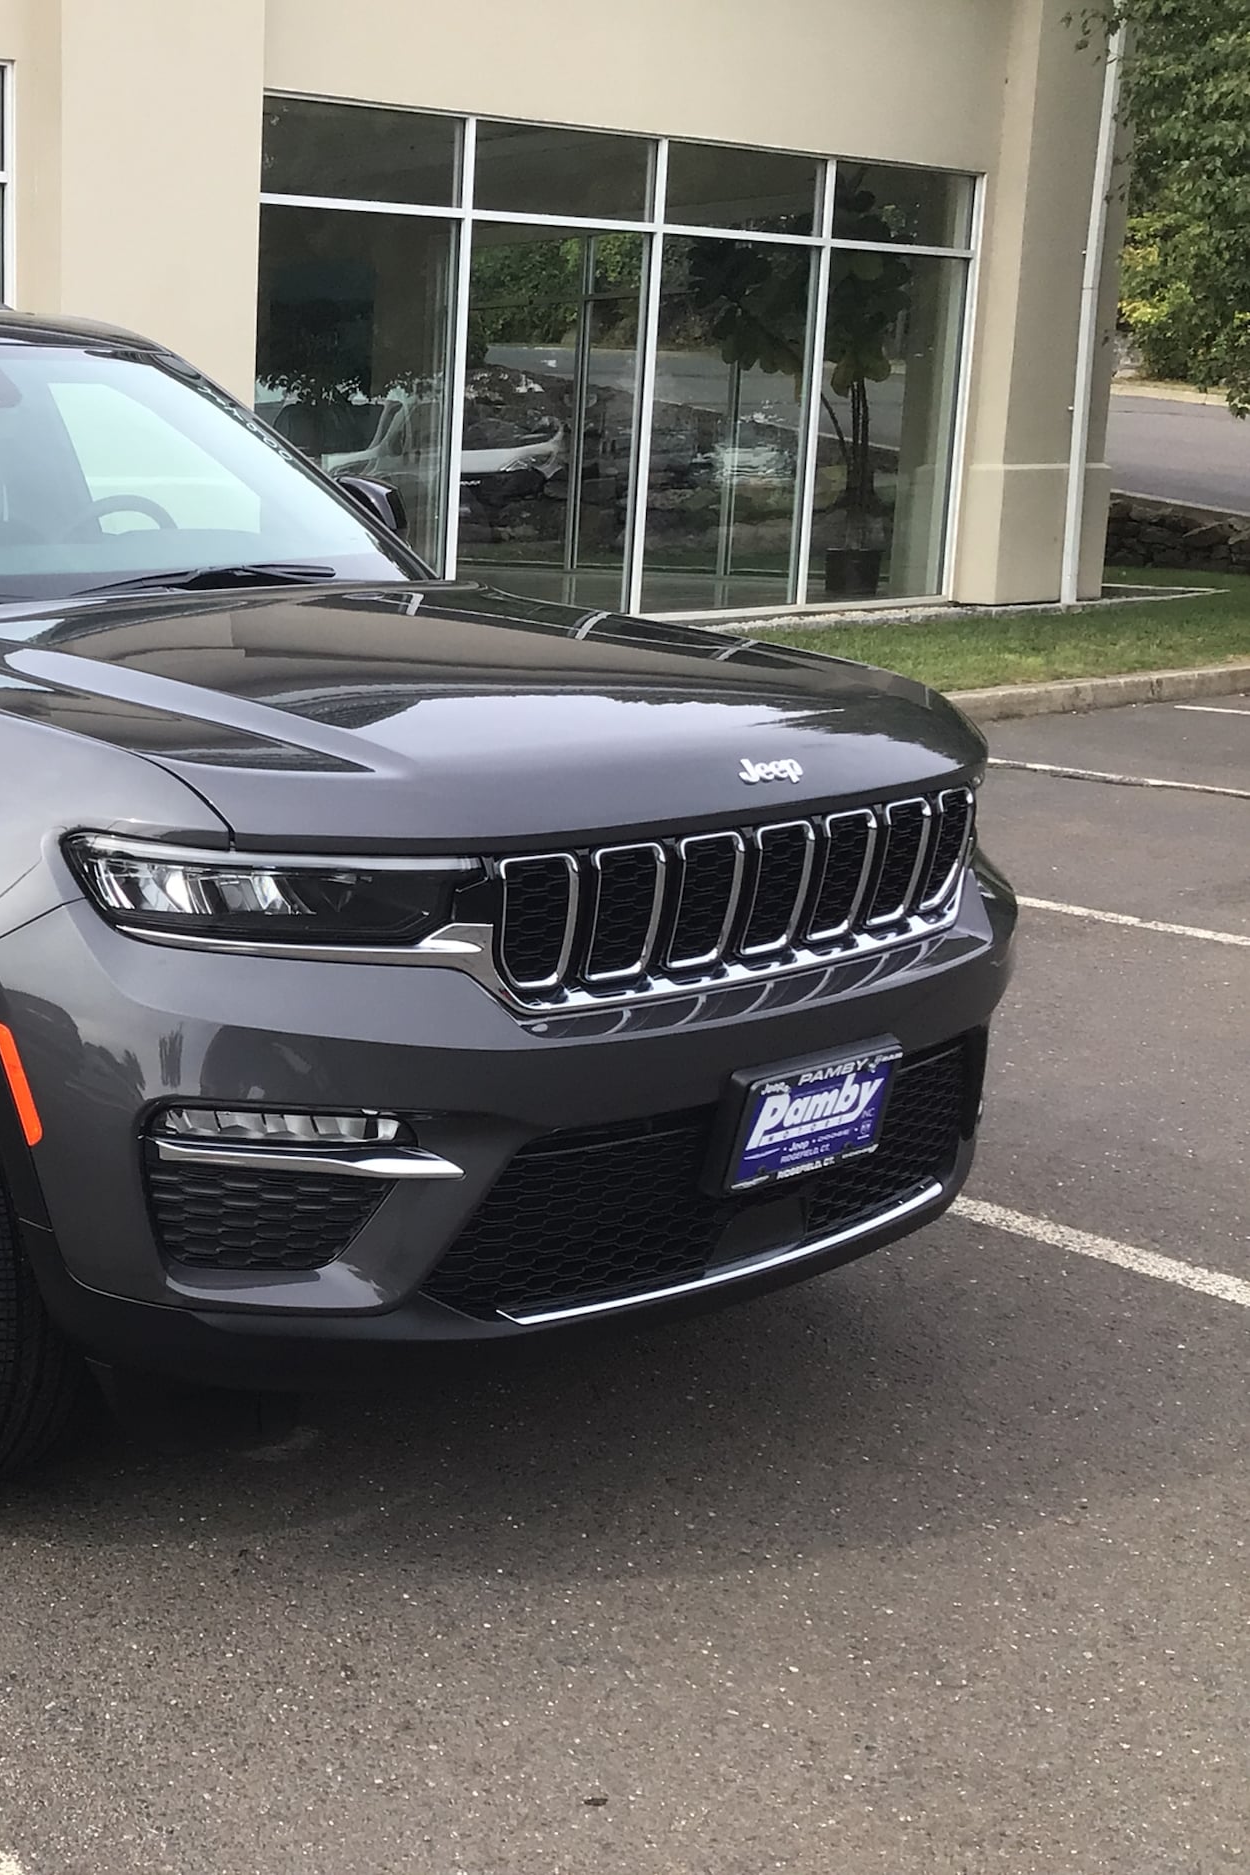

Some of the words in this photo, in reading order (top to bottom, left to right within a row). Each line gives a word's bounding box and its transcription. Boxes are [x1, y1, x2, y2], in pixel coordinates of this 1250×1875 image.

[737, 758, 803, 785] Jeep
[797, 1057, 869, 1087] PAMBY
[745, 1072, 886, 1151] Pamby
